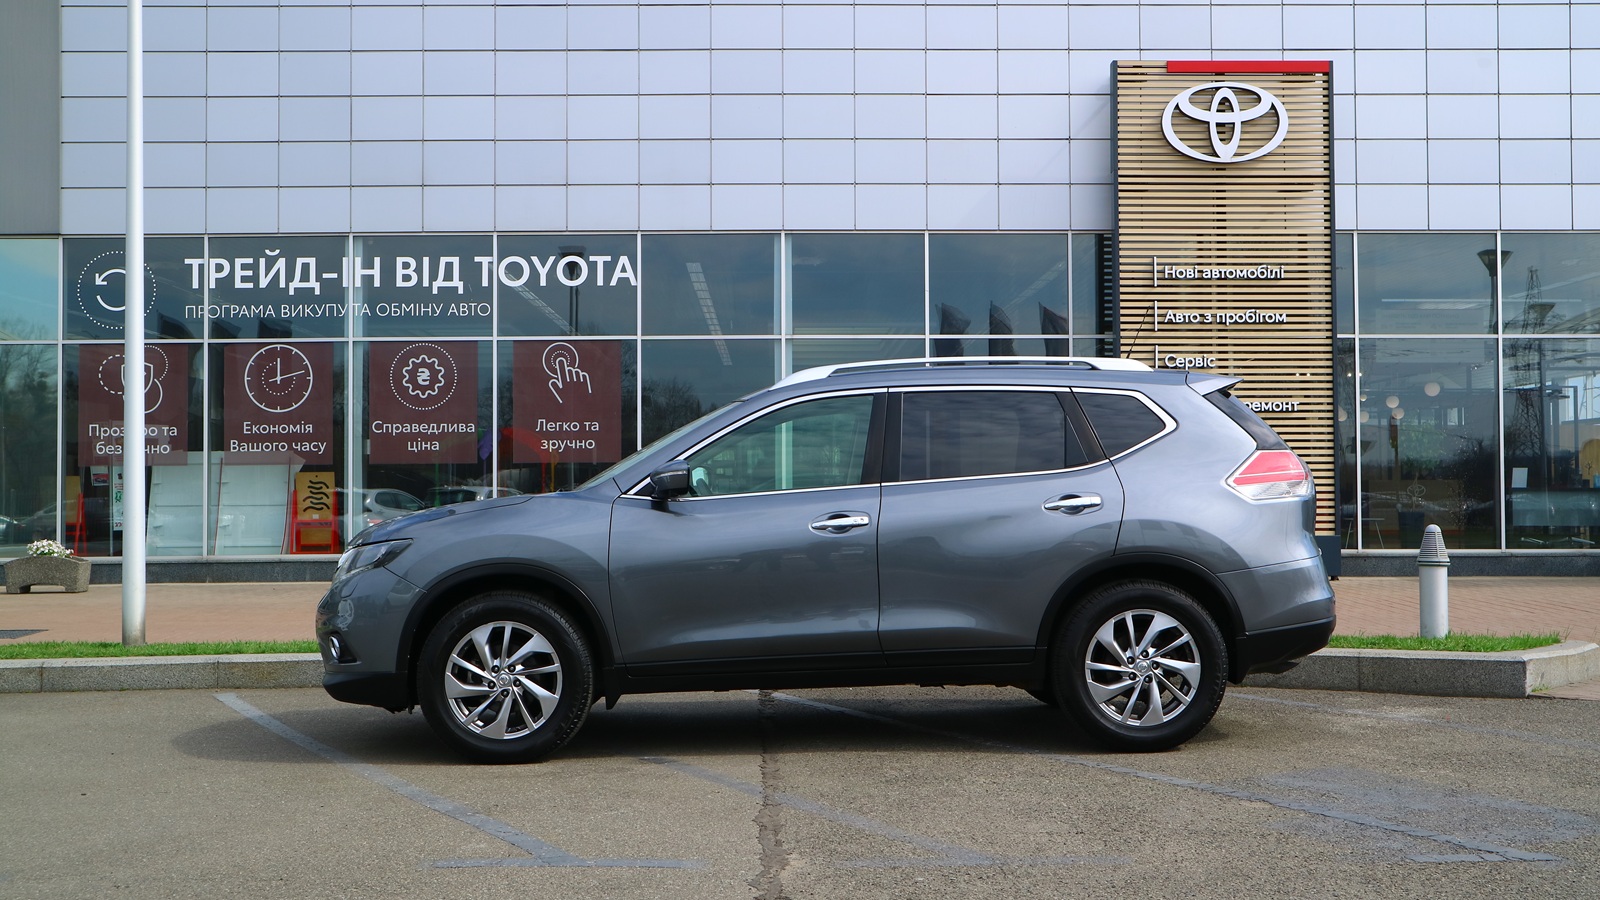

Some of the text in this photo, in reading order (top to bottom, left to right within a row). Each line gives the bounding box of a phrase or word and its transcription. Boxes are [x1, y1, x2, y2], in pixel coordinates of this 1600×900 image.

[184, 248, 637, 295] ТРЕЙД-ІН ВІД TOYOTA
[1164, 265, 1285, 279] Нові автомобілі
[185, 302, 491, 319] ПРОГРАМА ВИКУПУ ТА ОБМІНУ АВТО
[1164, 309, 1287, 326] Авто з пробігом
[1164, 354, 1216, 370] Сервіс
[161, 426, 178, 436] та
[243, 421, 313, 435] Економія
[371, 420, 476, 436] Справедлива
[535, 419, 600, 432] Легко та
[96, 441, 170, 455] безчно
[230, 439, 327, 455] Вашого часу
[407, 438, 440, 452] ціна
[540, 437, 596, 453] зручно
